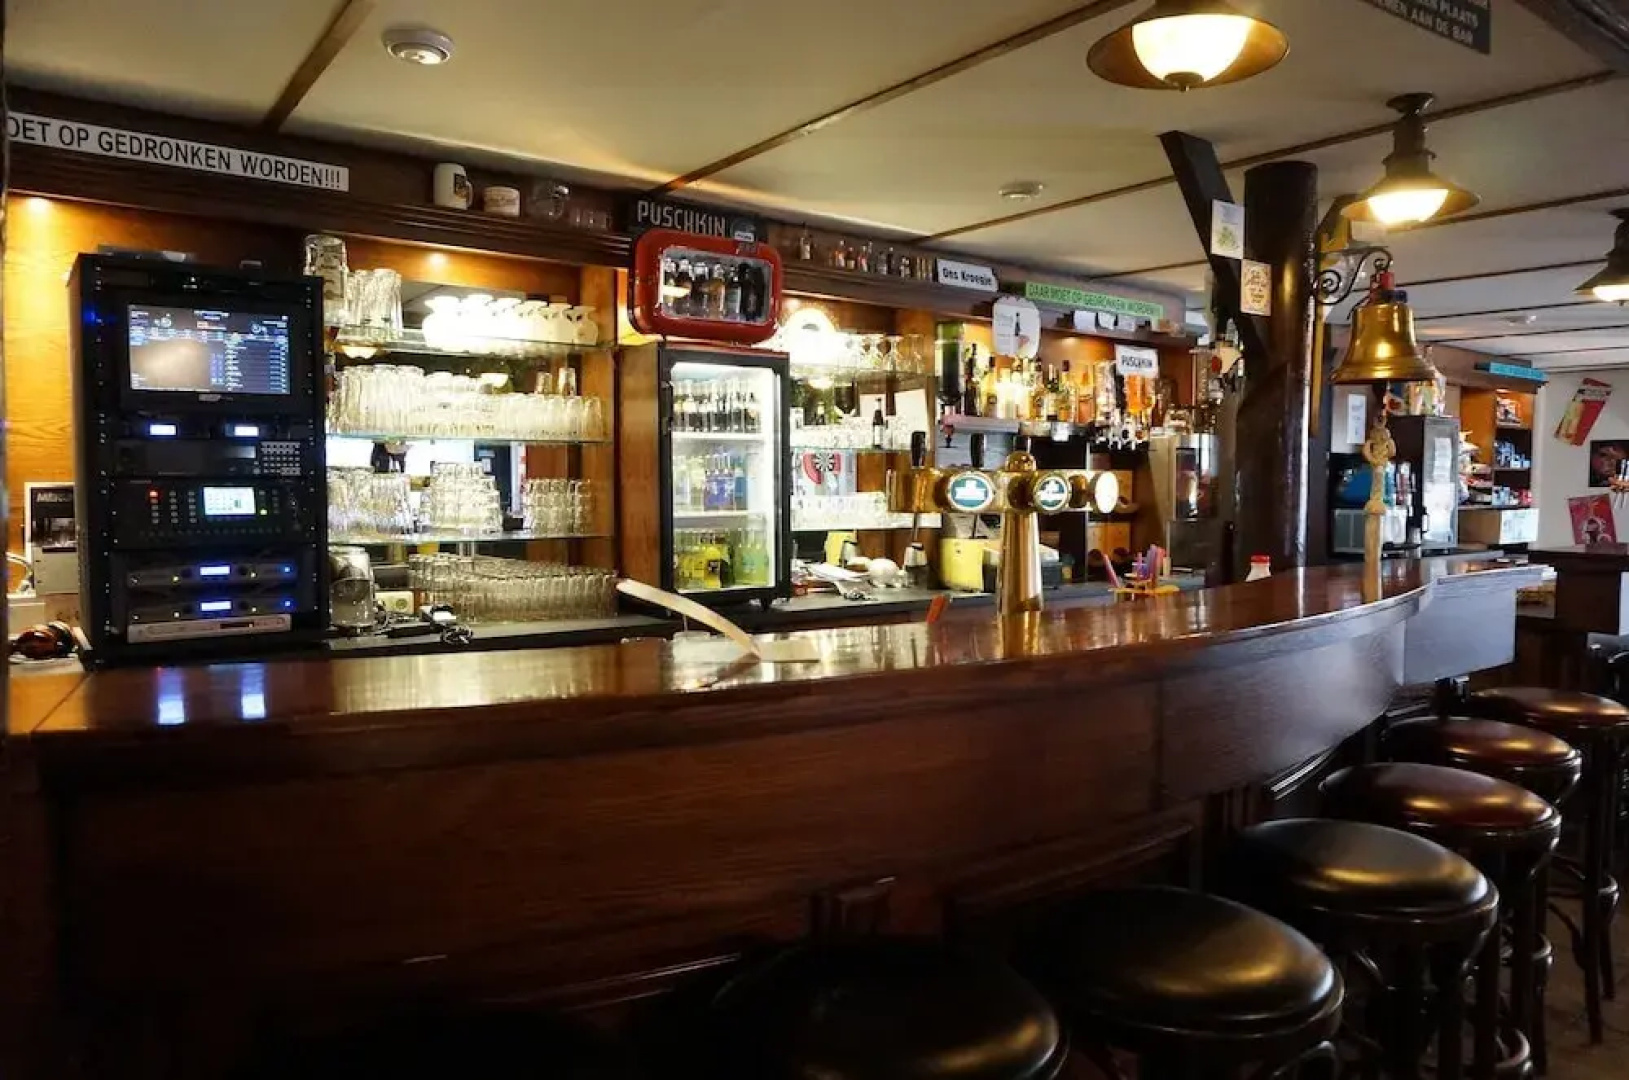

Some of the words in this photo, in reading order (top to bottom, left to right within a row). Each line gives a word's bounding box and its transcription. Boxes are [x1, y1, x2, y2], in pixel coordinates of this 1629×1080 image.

[59, 125, 89, 148] OP
[97, 131, 231, 170] GEDRONKEN
[240, 155, 340, 188] WORDEN!!!
[637, 201, 726, 238] PUSCHKIN
